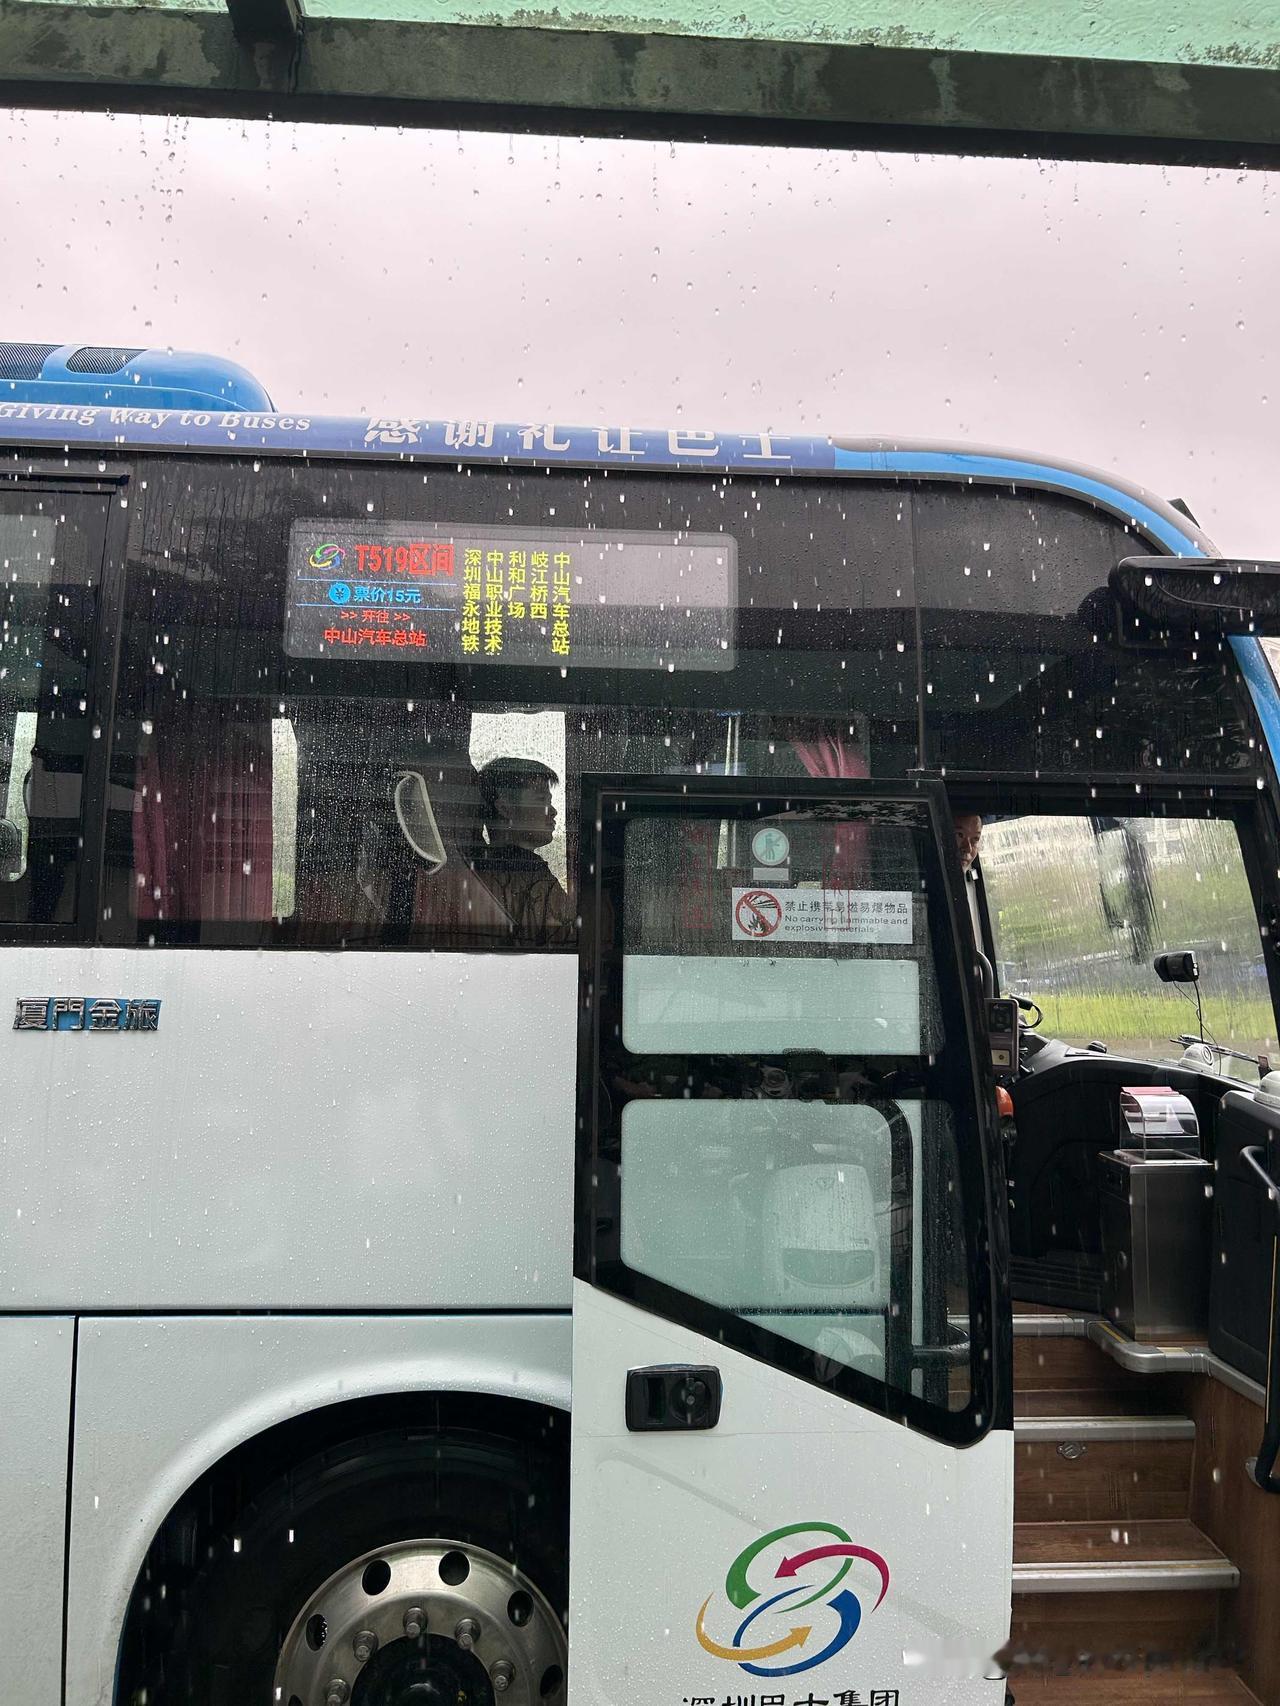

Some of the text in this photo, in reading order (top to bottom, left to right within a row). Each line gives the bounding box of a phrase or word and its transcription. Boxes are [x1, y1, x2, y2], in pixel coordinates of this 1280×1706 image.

[0, 404, 312, 431] Giving Way to Buses
[364, 417, 792, 459] 感谢礼让巴士
[354, 543, 455, 576] T519区间
[353, 586, 421, 604] 票价15元
[507, 550, 526, 619] 利和广场
[529, 551, 549, 620] 岐江桥西
[361, 609, 390, 624] 开往
[551, 552, 571, 655] 中山汽车总站
[324, 627, 428, 647] 中山汽车总站
[784, 901, 908, 914] 禁止携带易燃易爆物品
[800, 916, 838, 926] carryng
[890, 917, 908, 925] and
